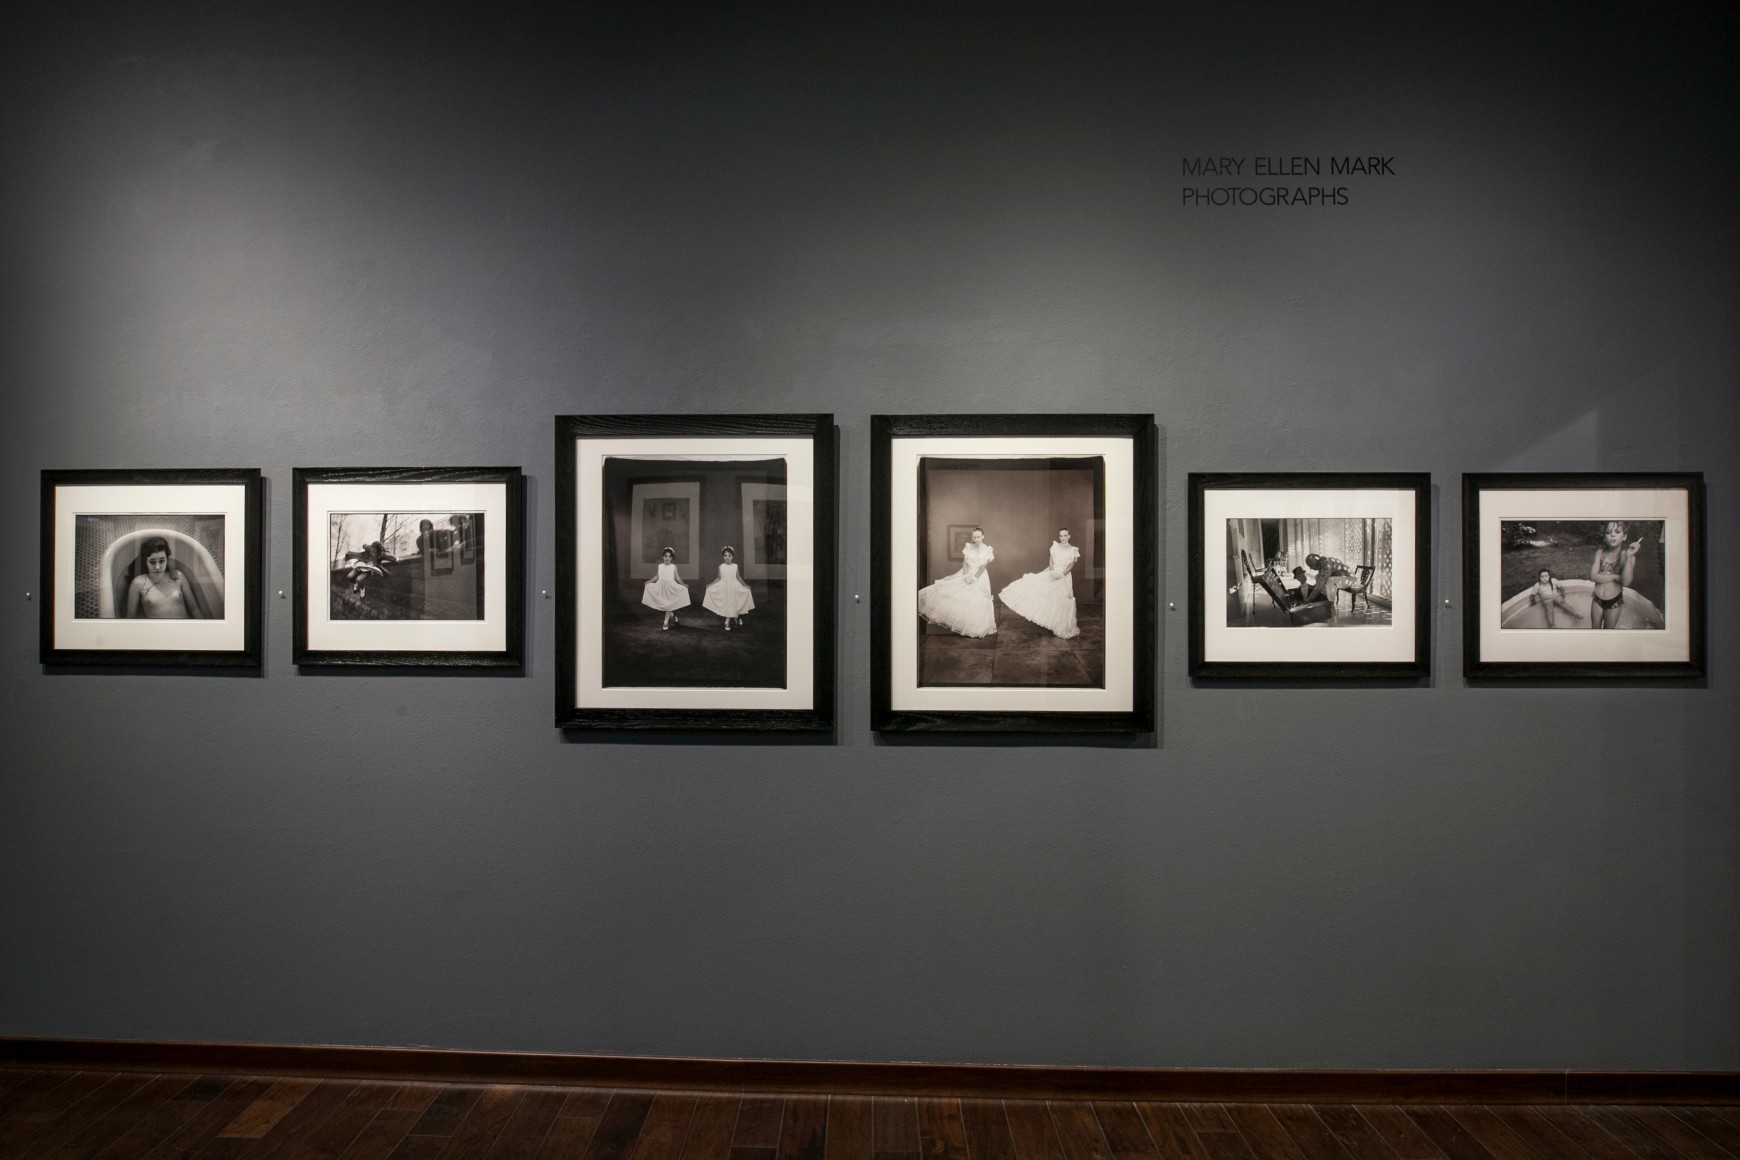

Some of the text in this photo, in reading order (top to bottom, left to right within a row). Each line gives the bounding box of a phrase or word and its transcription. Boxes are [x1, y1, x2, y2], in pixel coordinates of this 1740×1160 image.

[1182, 156, 1396, 176] MARY ELLEN MARK
[1182, 187, 1349, 206] PHOTOGRAPHS
